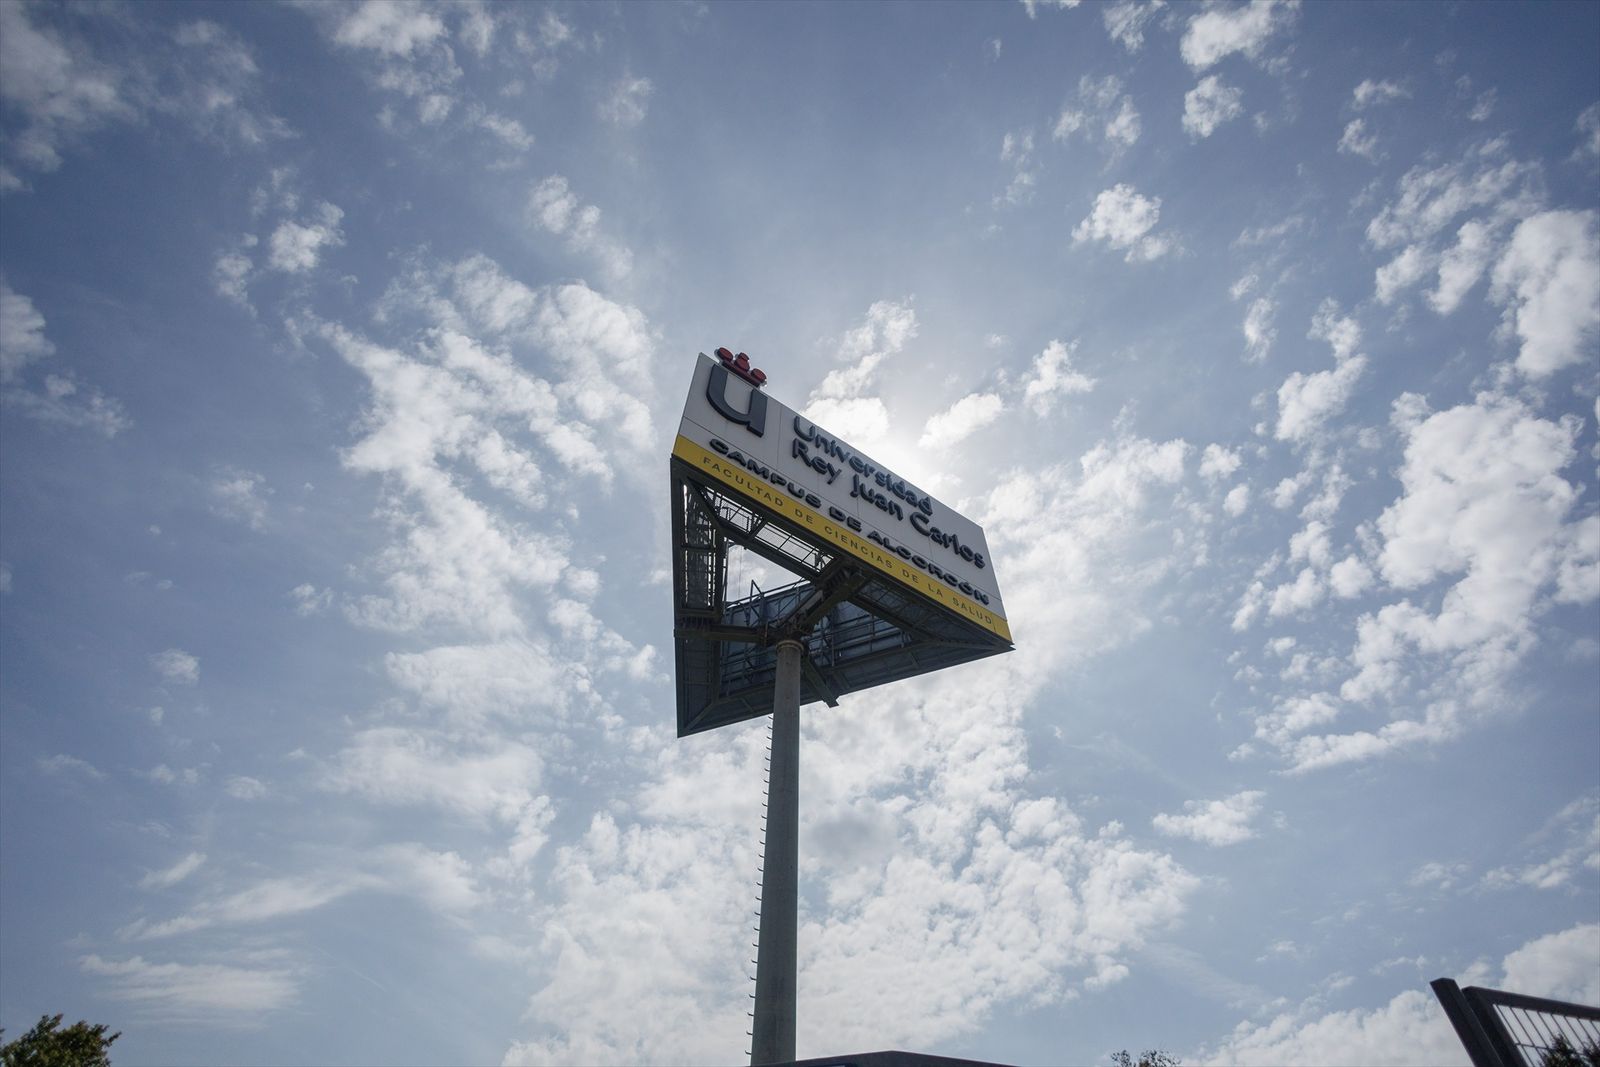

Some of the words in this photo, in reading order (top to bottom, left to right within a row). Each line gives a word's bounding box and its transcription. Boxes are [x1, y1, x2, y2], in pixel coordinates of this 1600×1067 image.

[703, 456, 783, 507] FACULTAD
[795, 508, 813, 525] DE
[824, 526, 893, 569] CIENCIAS
[902, 569, 919, 584] DE
[928, 583, 944, 598] LA
[952, 597, 992, 625] SALUD
[709, 438, 821, 509] CAMPUS
[829, 506, 862, 532] DE
[867, 530, 989, 606] ALCORCÓN
[791, 438, 842, 485] Rey
[850, 474, 903, 521] Juan
[909, 512, 986, 569] Carlos
[793, 416, 933, 516] Universidad
